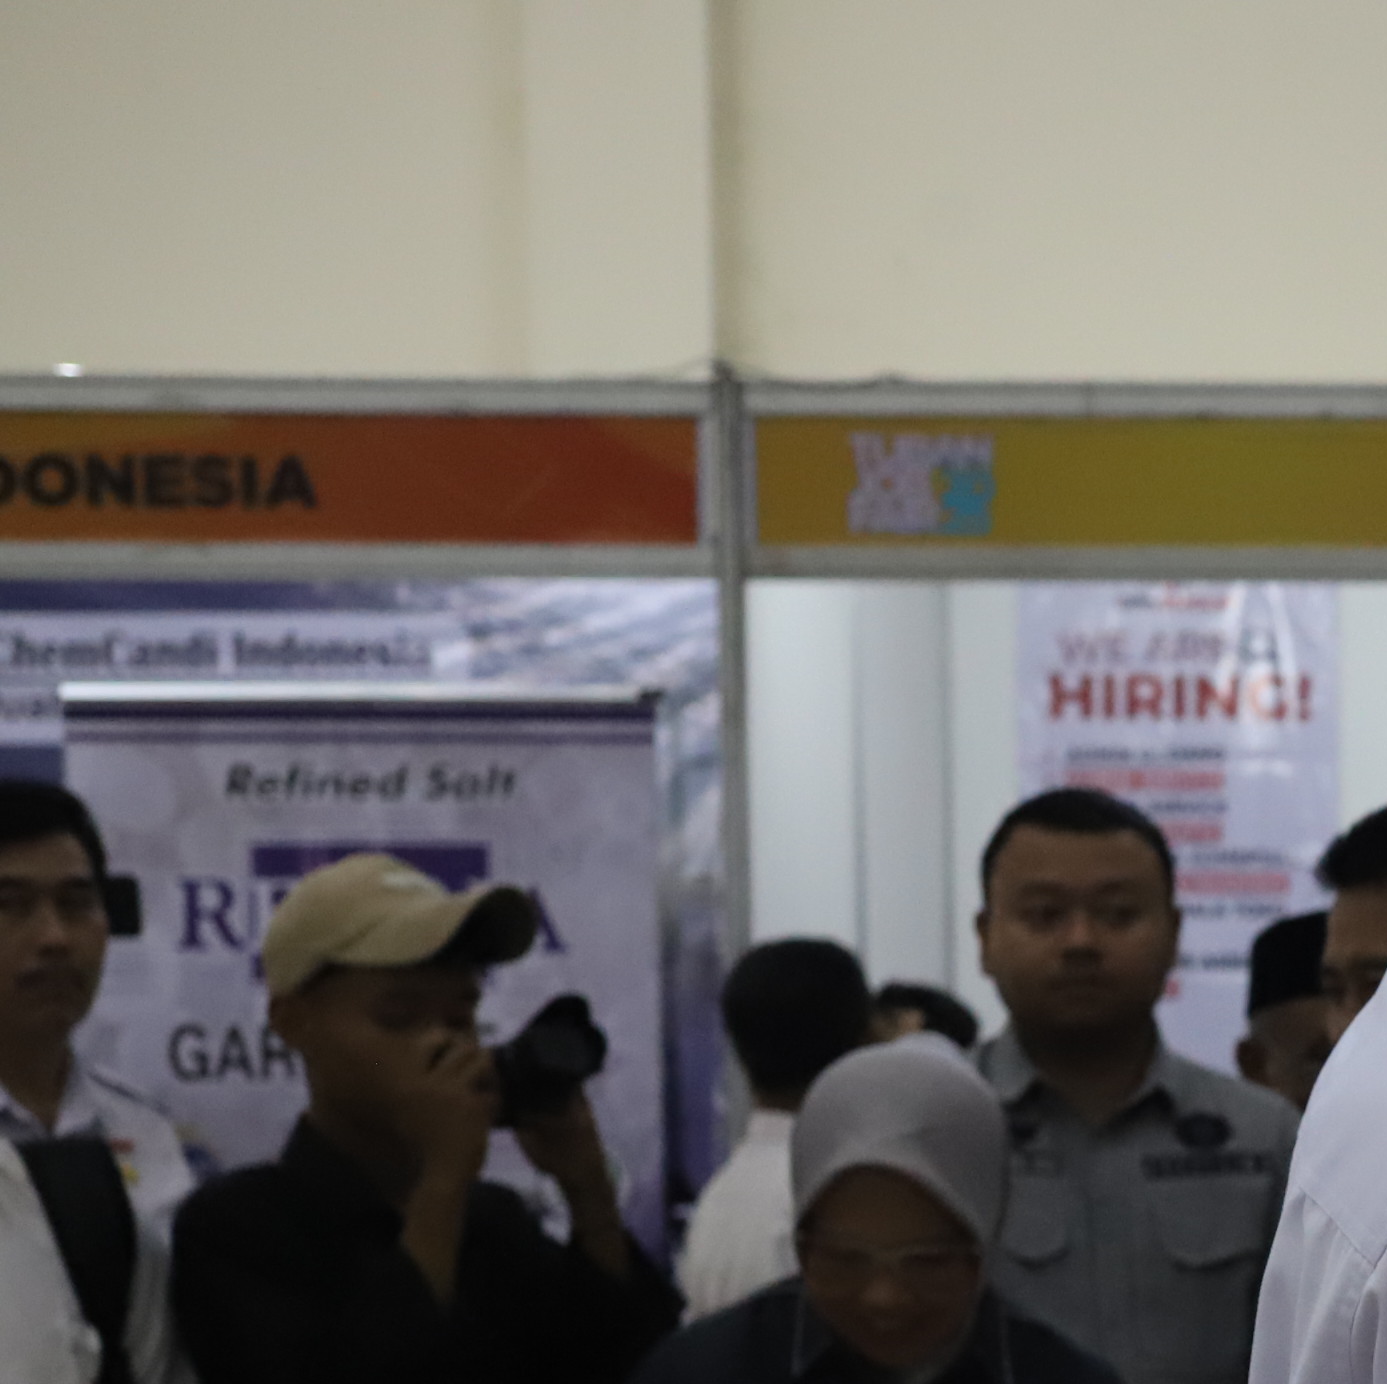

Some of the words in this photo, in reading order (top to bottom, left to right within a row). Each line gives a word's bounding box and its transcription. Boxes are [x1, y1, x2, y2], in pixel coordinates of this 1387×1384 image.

[1049, 672, 1314, 722] HIRING!
[225, 763, 407, 797] Refined
[426, 764, 516, 797] Salt
